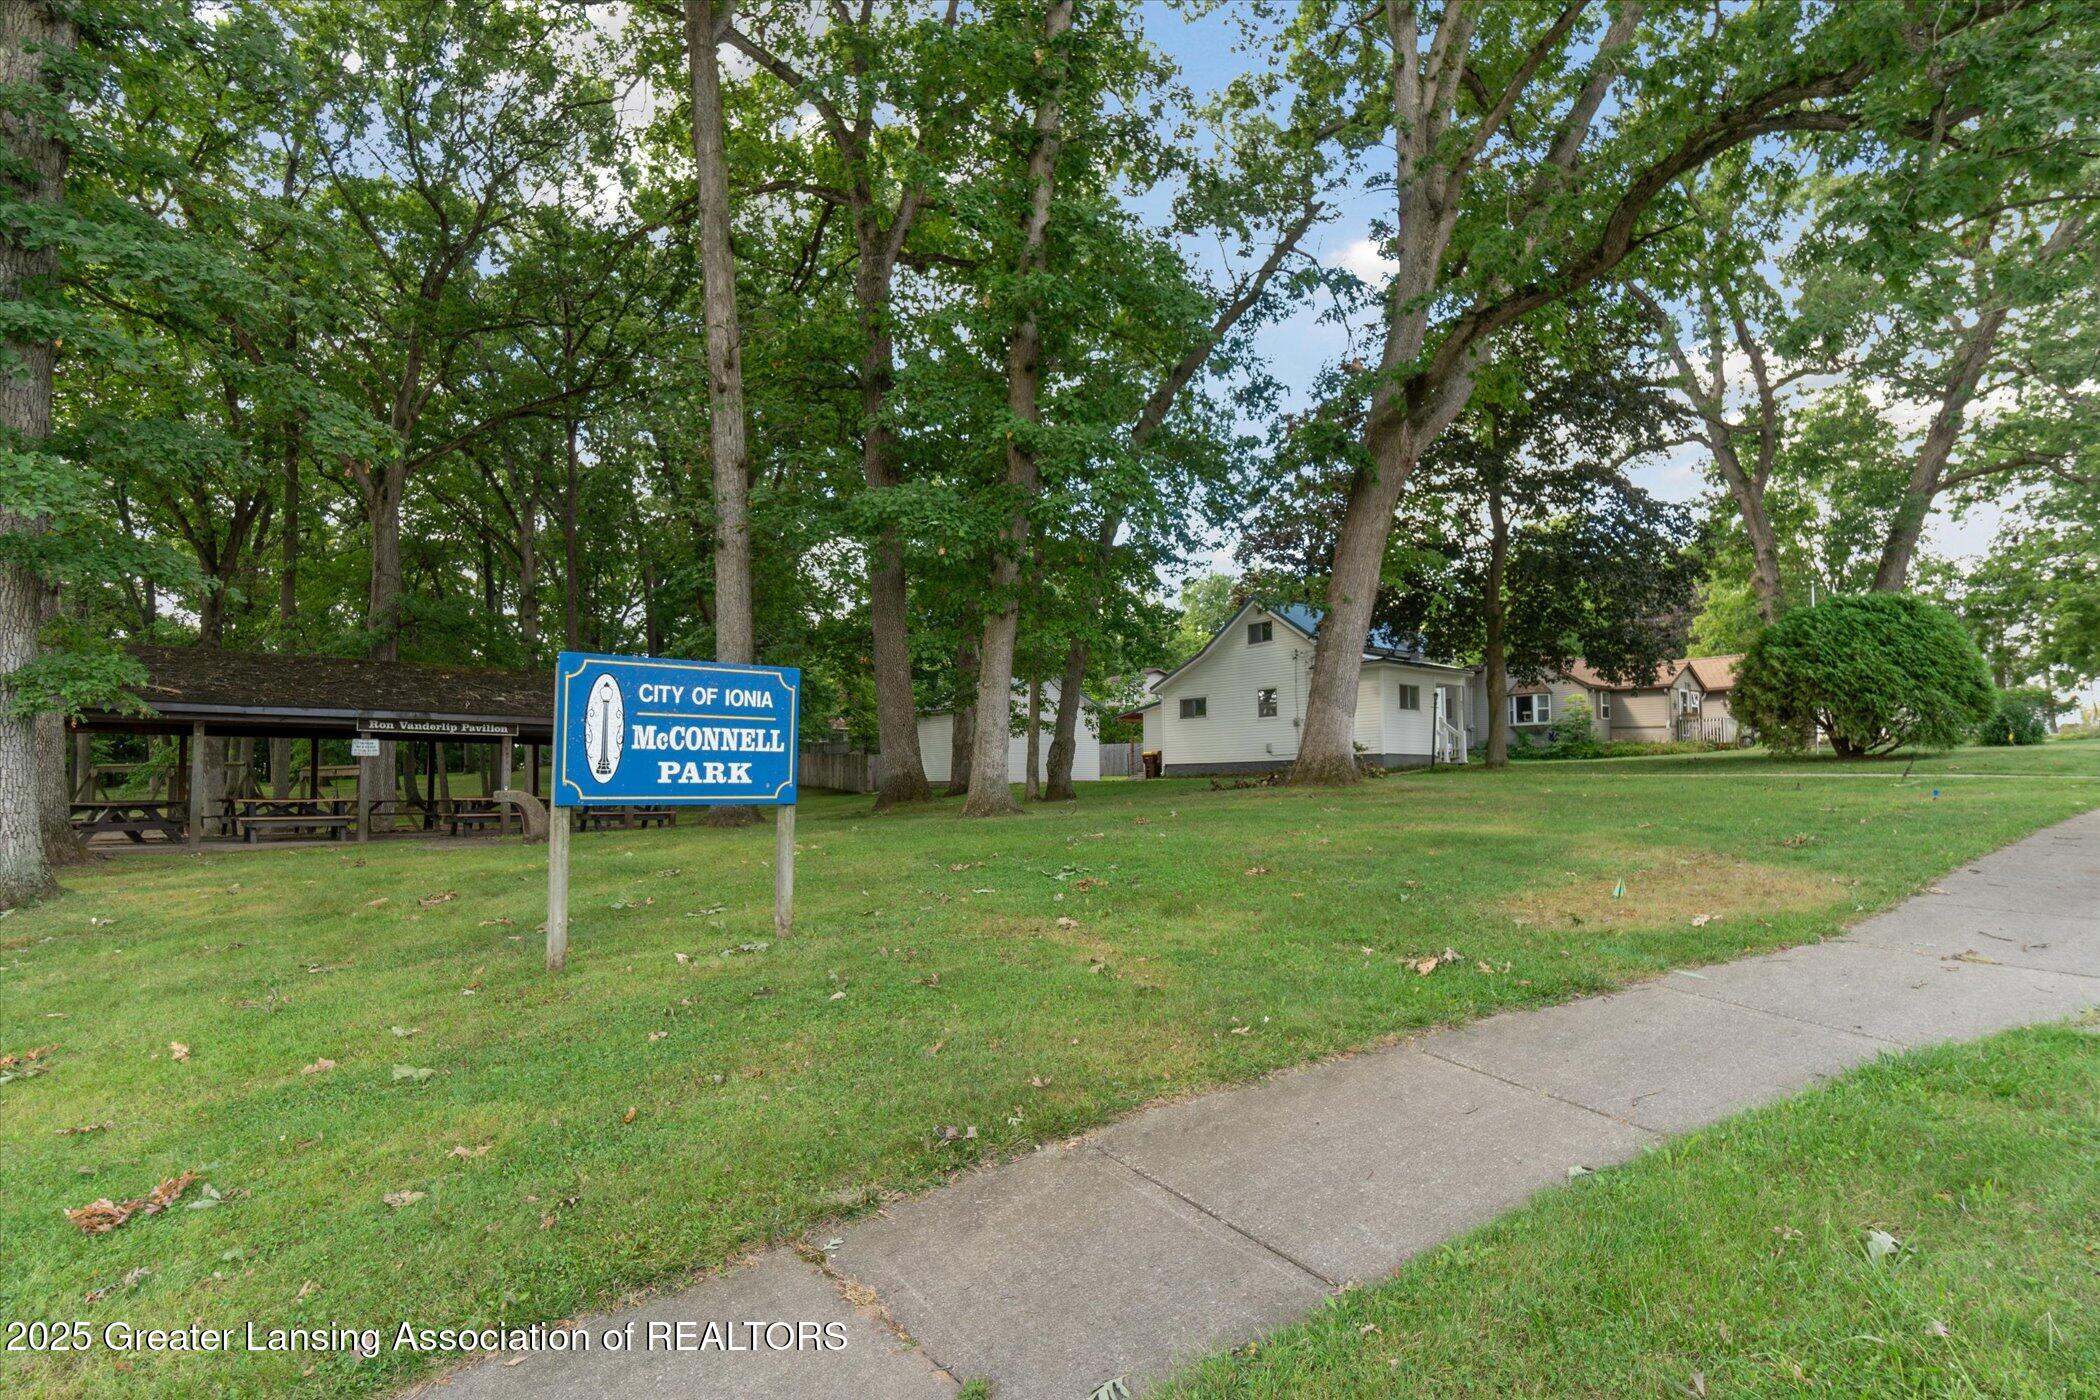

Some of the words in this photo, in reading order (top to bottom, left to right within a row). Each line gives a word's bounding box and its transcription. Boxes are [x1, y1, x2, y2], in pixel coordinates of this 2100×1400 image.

[638, 683, 684, 704] CITY
[691, 687, 718, 706] OF
[725, 689, 773, 708] IONIA
[368, 720, 394, 729] Ron
[400, 721, 457, 733] Vanderlip
[461, 724, 508, 733] Pavilion
[631, 725, 784, 752] McCONNELL
[657, 761, 752, 784] PARK
